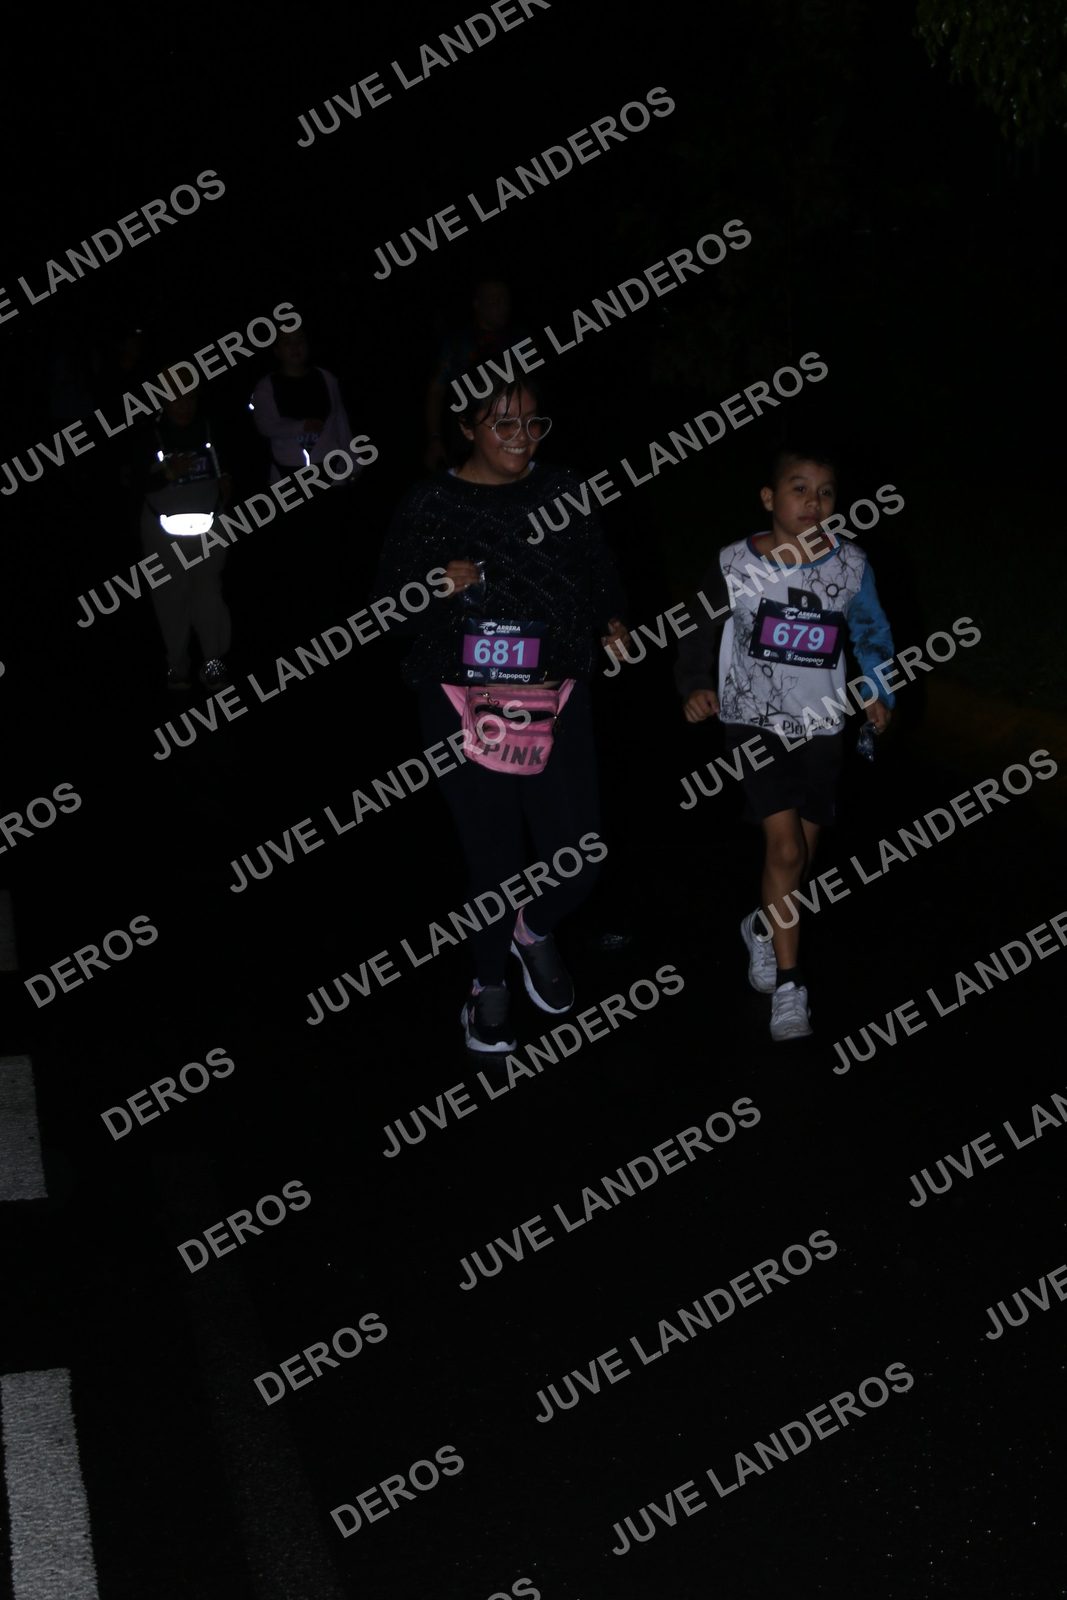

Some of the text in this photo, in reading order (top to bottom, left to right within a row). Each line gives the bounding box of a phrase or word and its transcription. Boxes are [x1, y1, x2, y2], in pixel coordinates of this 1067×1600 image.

[773, 622, 825, 651] 679
[474, 639, 525, 666] 681
[498, 672, 531, 683] Zapopan
[482, 743, 545, 766] PINK
